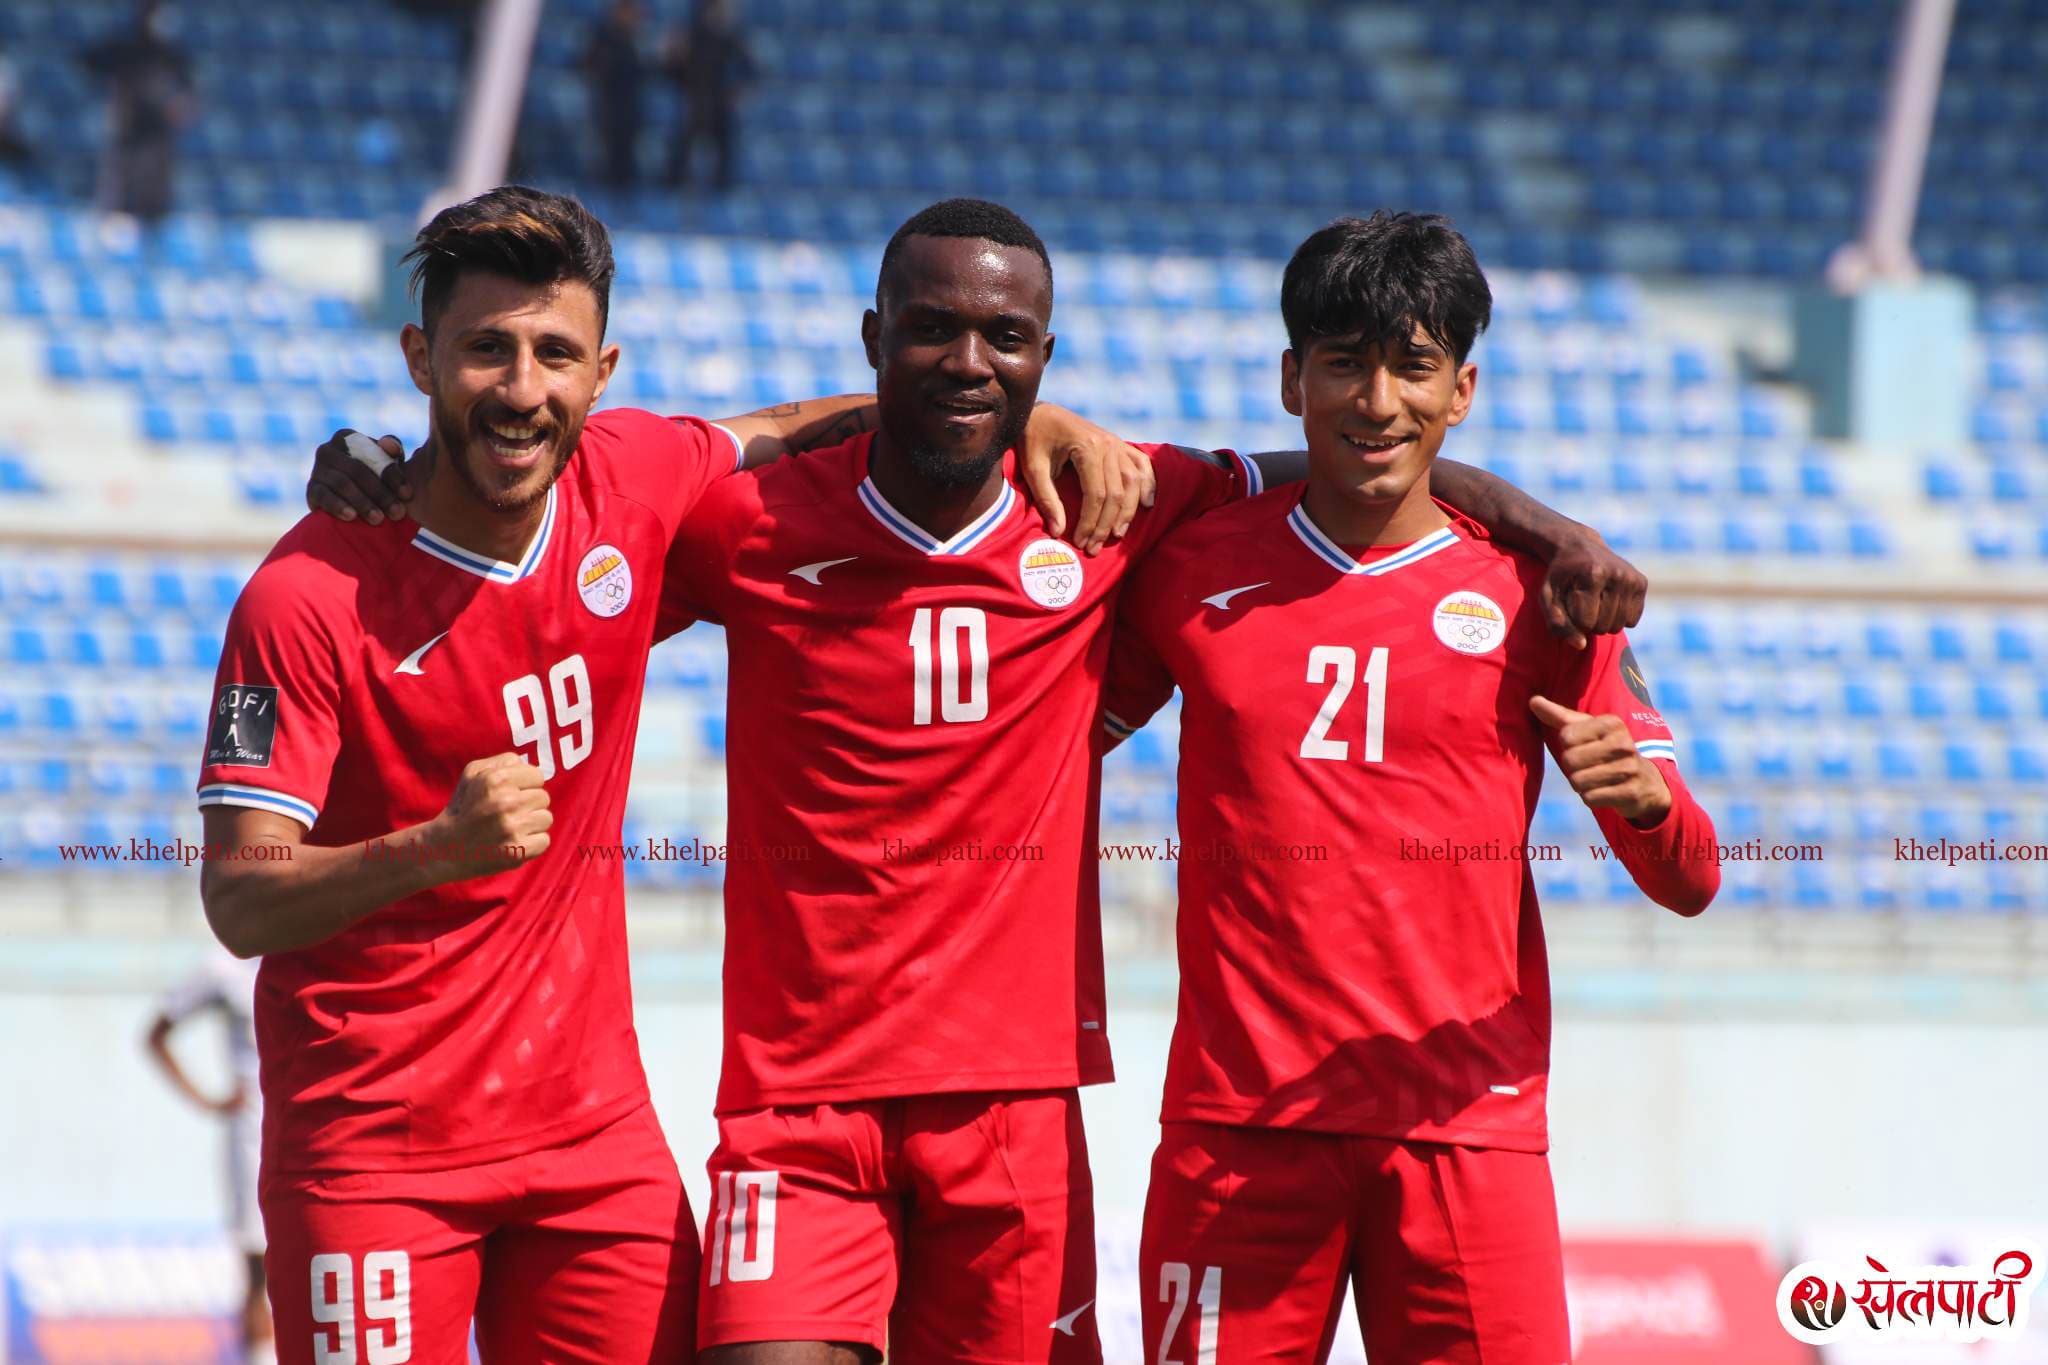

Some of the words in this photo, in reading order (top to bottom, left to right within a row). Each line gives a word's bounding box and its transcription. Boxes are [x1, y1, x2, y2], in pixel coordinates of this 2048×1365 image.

[502, 654, 594, 782] 99
[909, 607, 990, 725] 10
[1300, 645, 1389, 763] 21
[709, 1170, 780, 1284] 10
[311, 1250, 412, 1365] 99
[1157, 1262, 1222, 1365] 21
